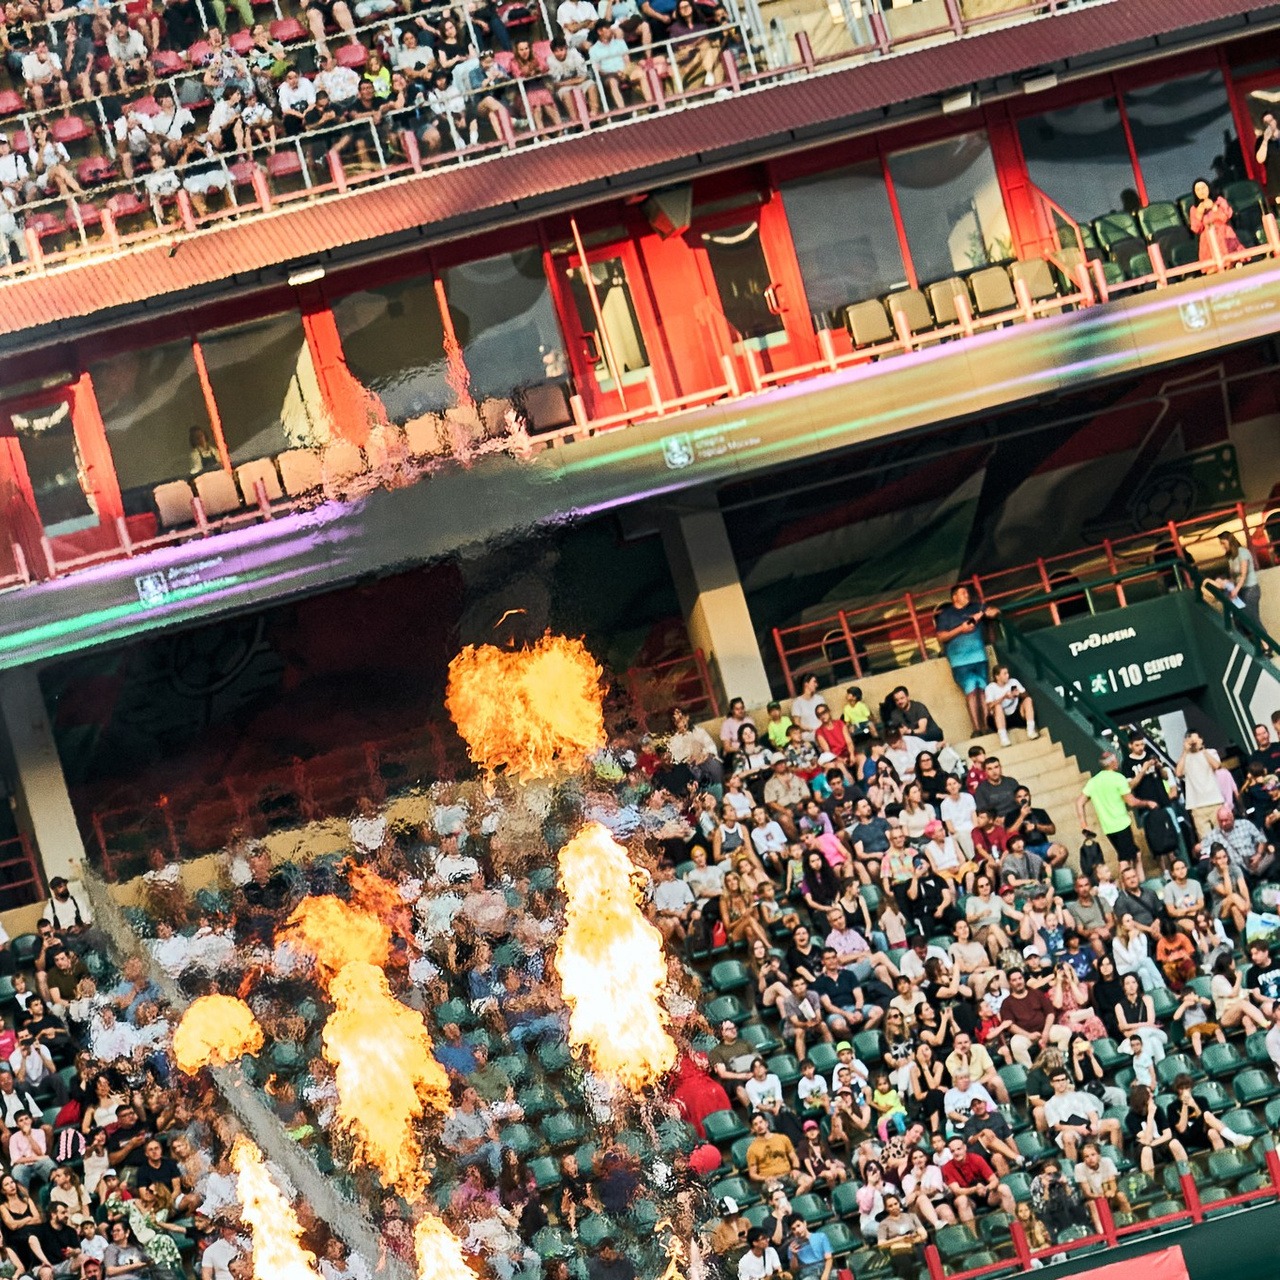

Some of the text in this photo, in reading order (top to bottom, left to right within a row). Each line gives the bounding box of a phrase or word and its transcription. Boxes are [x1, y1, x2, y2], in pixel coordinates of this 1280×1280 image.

[1101, 627, 1137, 646] АРЕНА
[1118, 653, 1185, 688] 10 СЕКТОР
